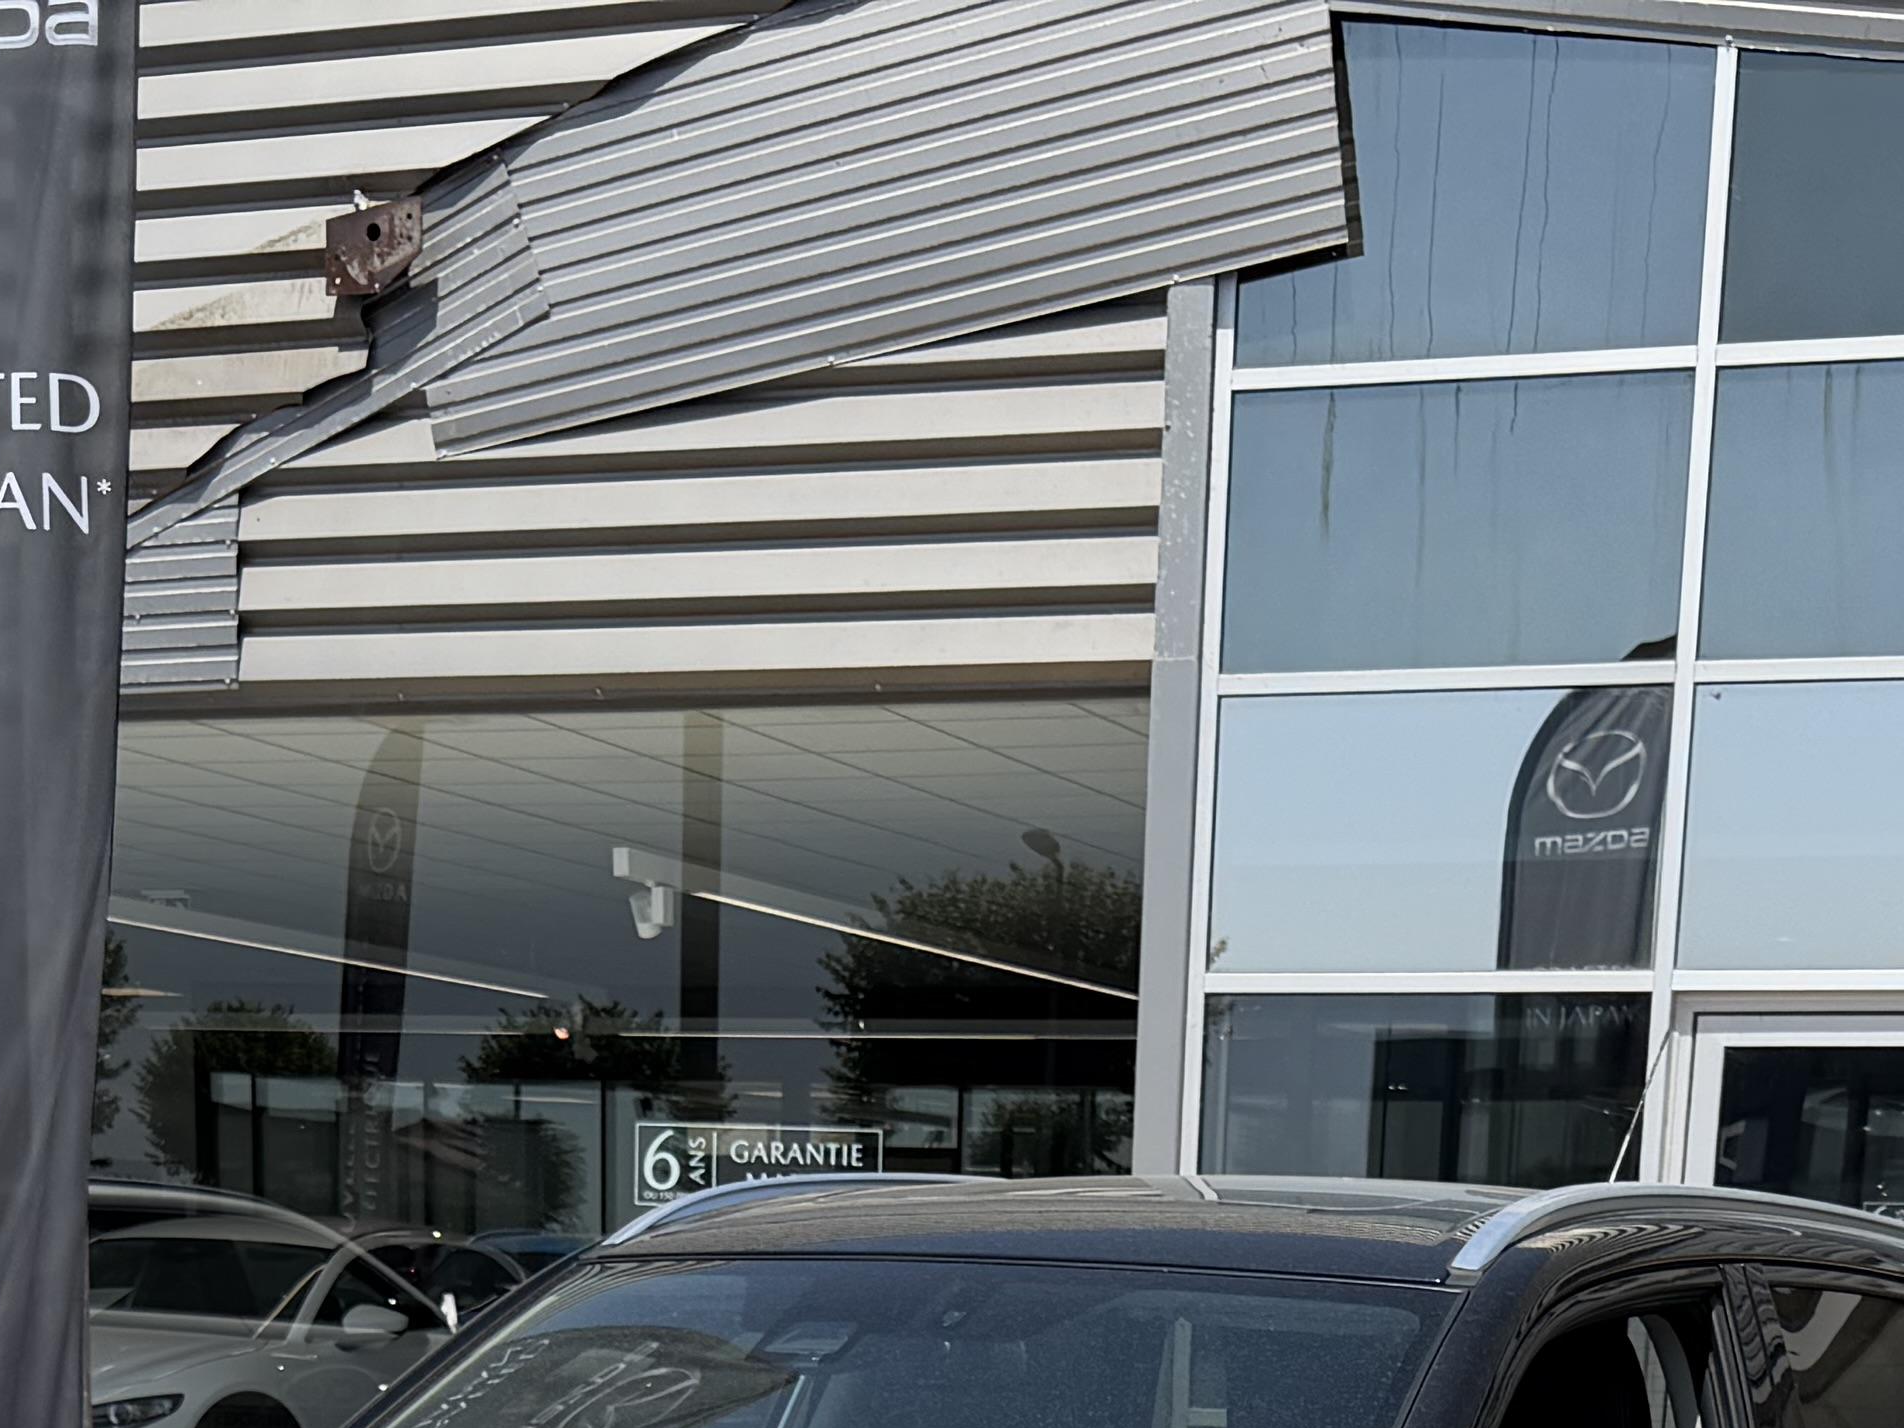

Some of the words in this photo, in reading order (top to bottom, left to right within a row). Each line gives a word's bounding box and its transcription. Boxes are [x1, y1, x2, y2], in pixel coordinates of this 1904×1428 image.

[643, 1129, 681, 1190] 6
[688, 1136, 707, 1185] ANS
[730, 1139, 864, 1168] GARANTIE
